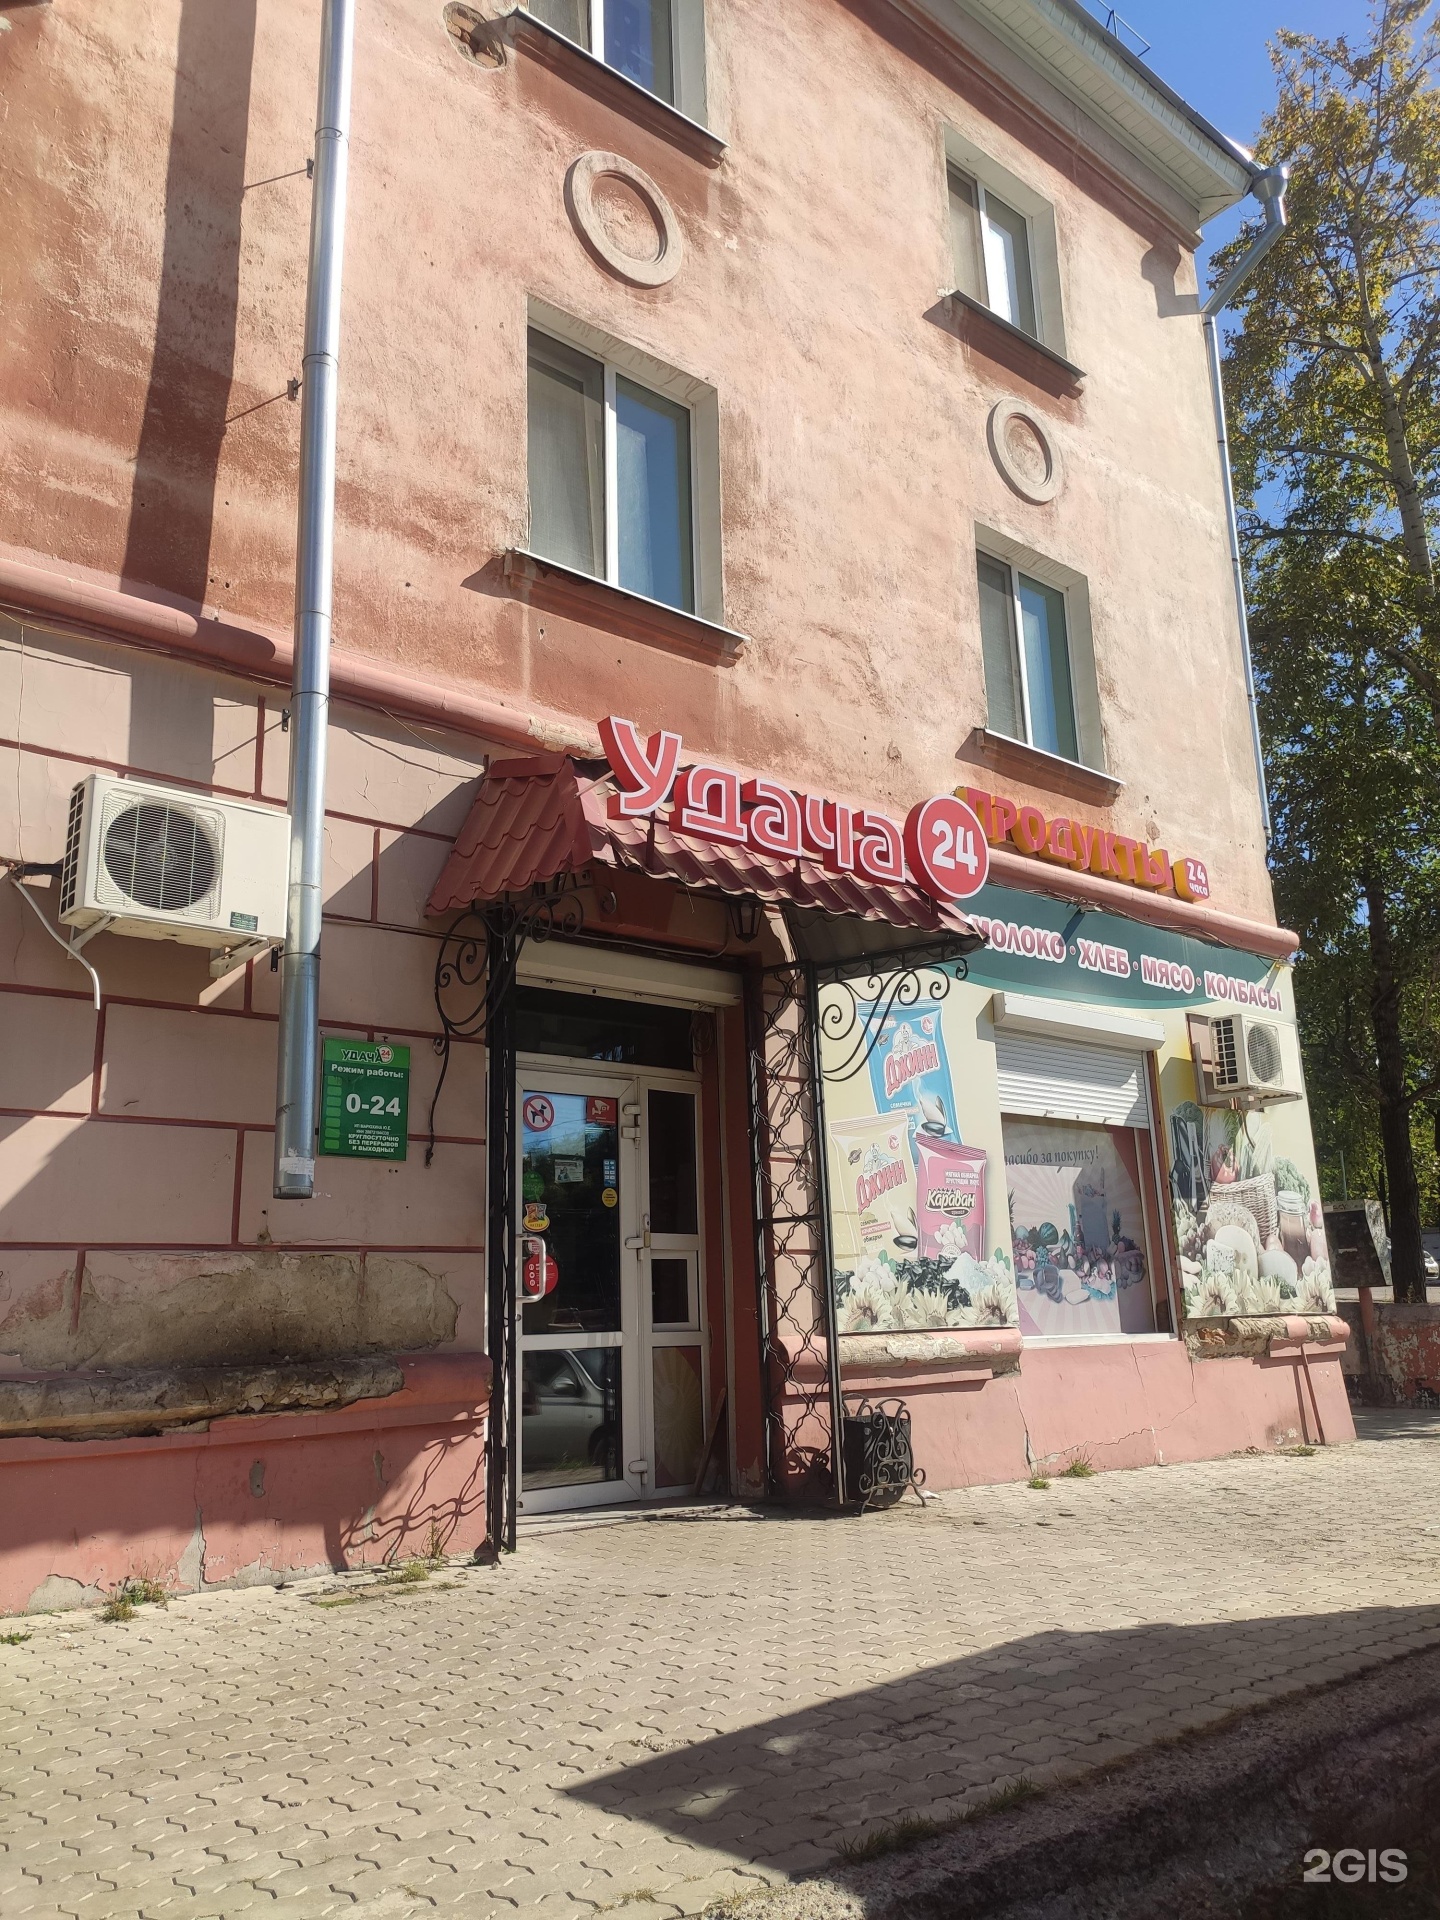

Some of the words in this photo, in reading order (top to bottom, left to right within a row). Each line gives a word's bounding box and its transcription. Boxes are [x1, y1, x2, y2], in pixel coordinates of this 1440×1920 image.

[602, 715, 907, 884] Удача
[931, 819, 979, 876] 24
[958, 786, 1174, 894] ПРОДУКТЫ
[1186, 860, 1207, 884] 24
[1188, 881, 1209, 897] часа
[1077, 937, 1131, 978] ХЛЕБ
[1141, 954, 1195, 994] МЯСО
[1204, 970, 1284, 1012] КОЛБАСЫ
[381, 1049, 391, 1057] 24
[331, 1063, 364, 1075] Режим
[366, 1068, 404, 1079] работы:
[346, 1093, 401, 1117] 0-24
[348, 1133, 400, 1142] КРУГЛОСУТОЧНО
[361, 1140, 399, 1148] ПЕРЕРЫВОВ
[1040, 1152, 1053, 1164] за
[1054, 1144, 1099, 1167] покупку!
